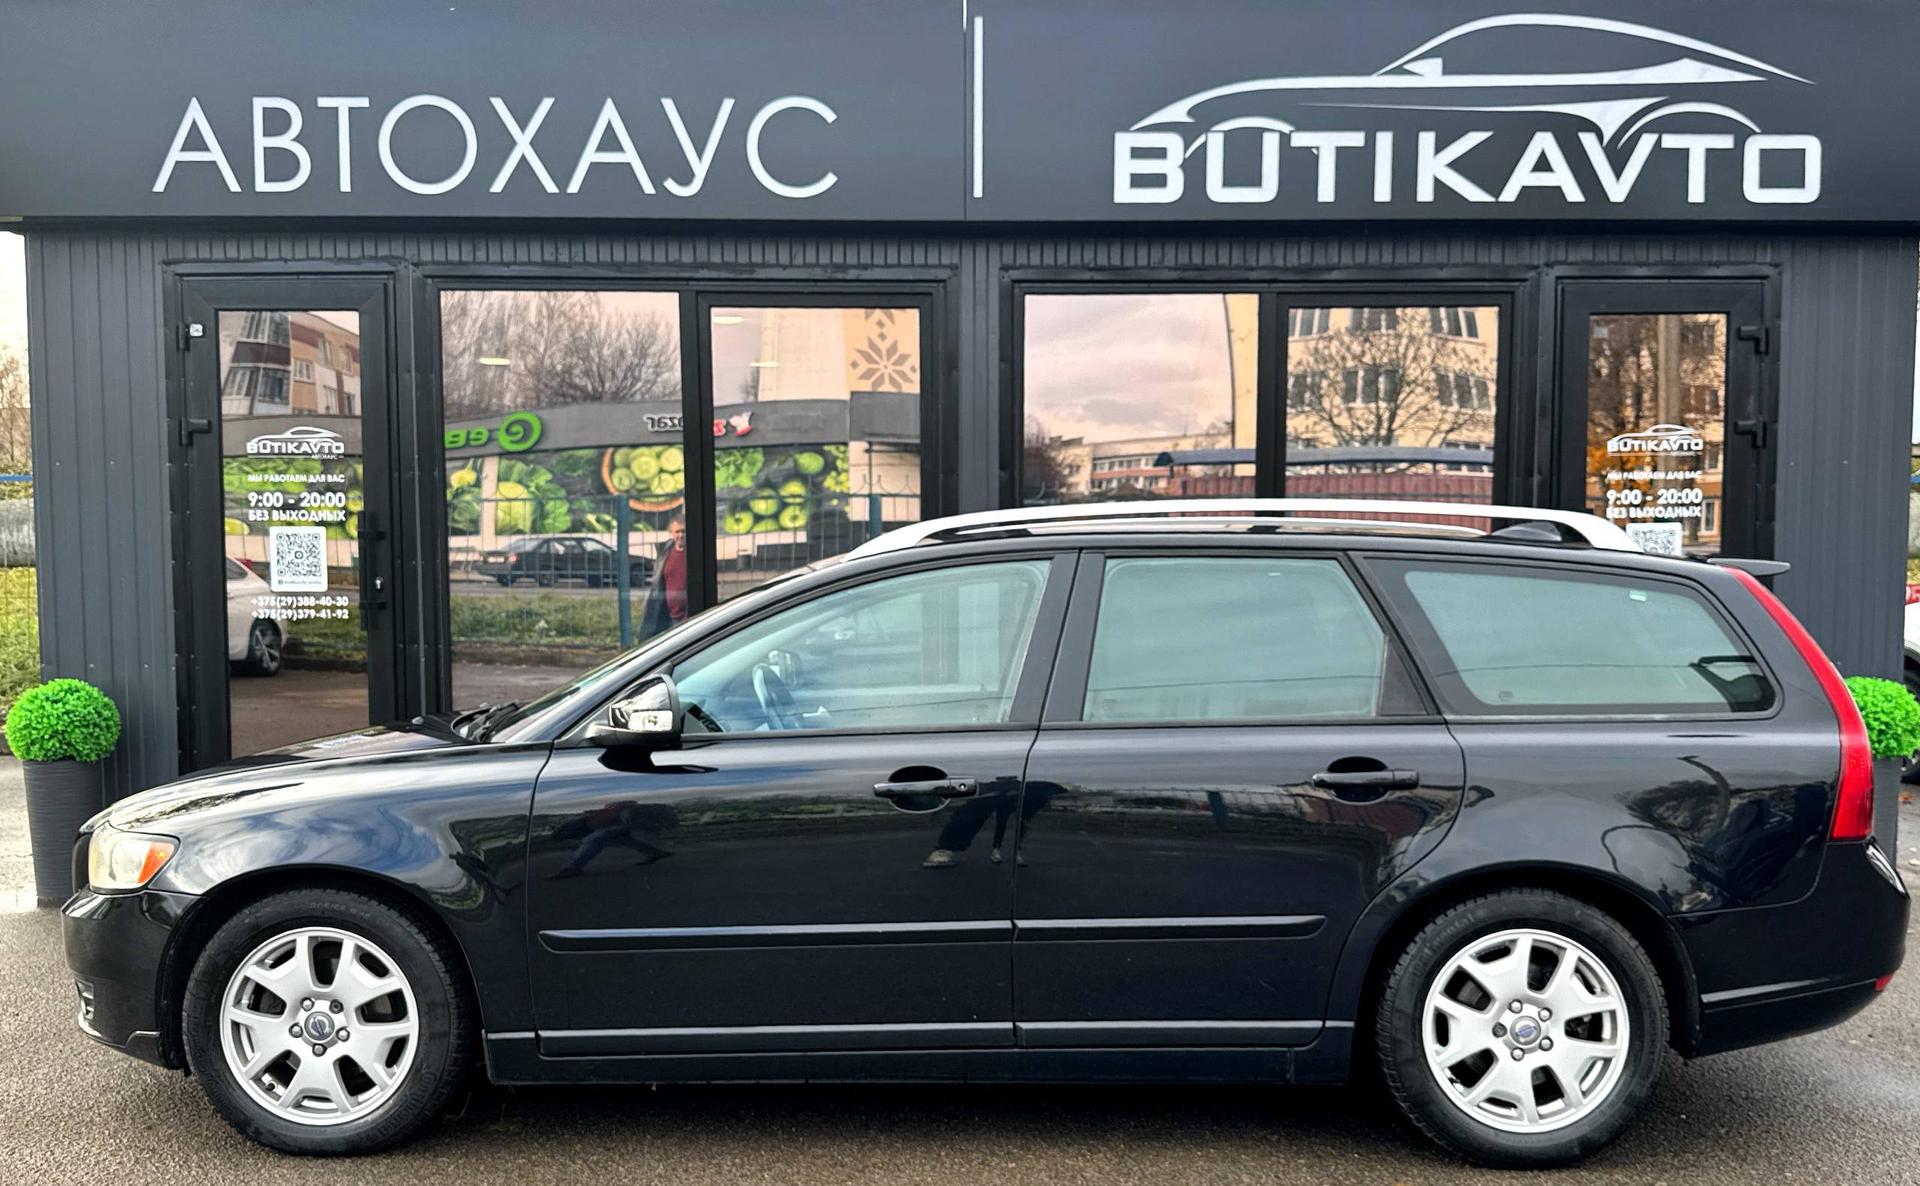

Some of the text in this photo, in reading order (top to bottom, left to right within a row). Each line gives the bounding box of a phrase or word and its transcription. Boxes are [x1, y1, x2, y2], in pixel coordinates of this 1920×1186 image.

[152, 94, 839, 198] АВТОХАУС
[1113, 131, 1821, 204] BUTIKAVTO
[246, 441, 345, 453] BUTIKAVTO
[1607, 439, 1704, 452] BUTIKAVTO
[248, 474, 345, 483] МЫ РАБОТАЕМ ДЛЯ ВАС
[248, 492, 283, 507] 9:00
[301, 492, 346, 507] 20:00
[1606, 489, 1642, 505] 9:00
[1657, 488, 1703, 504] 20:00
[249, 510, 346, 522] БЕЗ ВЫХОДНЫХ
[1629, 506, 1702, 518] ВЫХОДНЫХ
